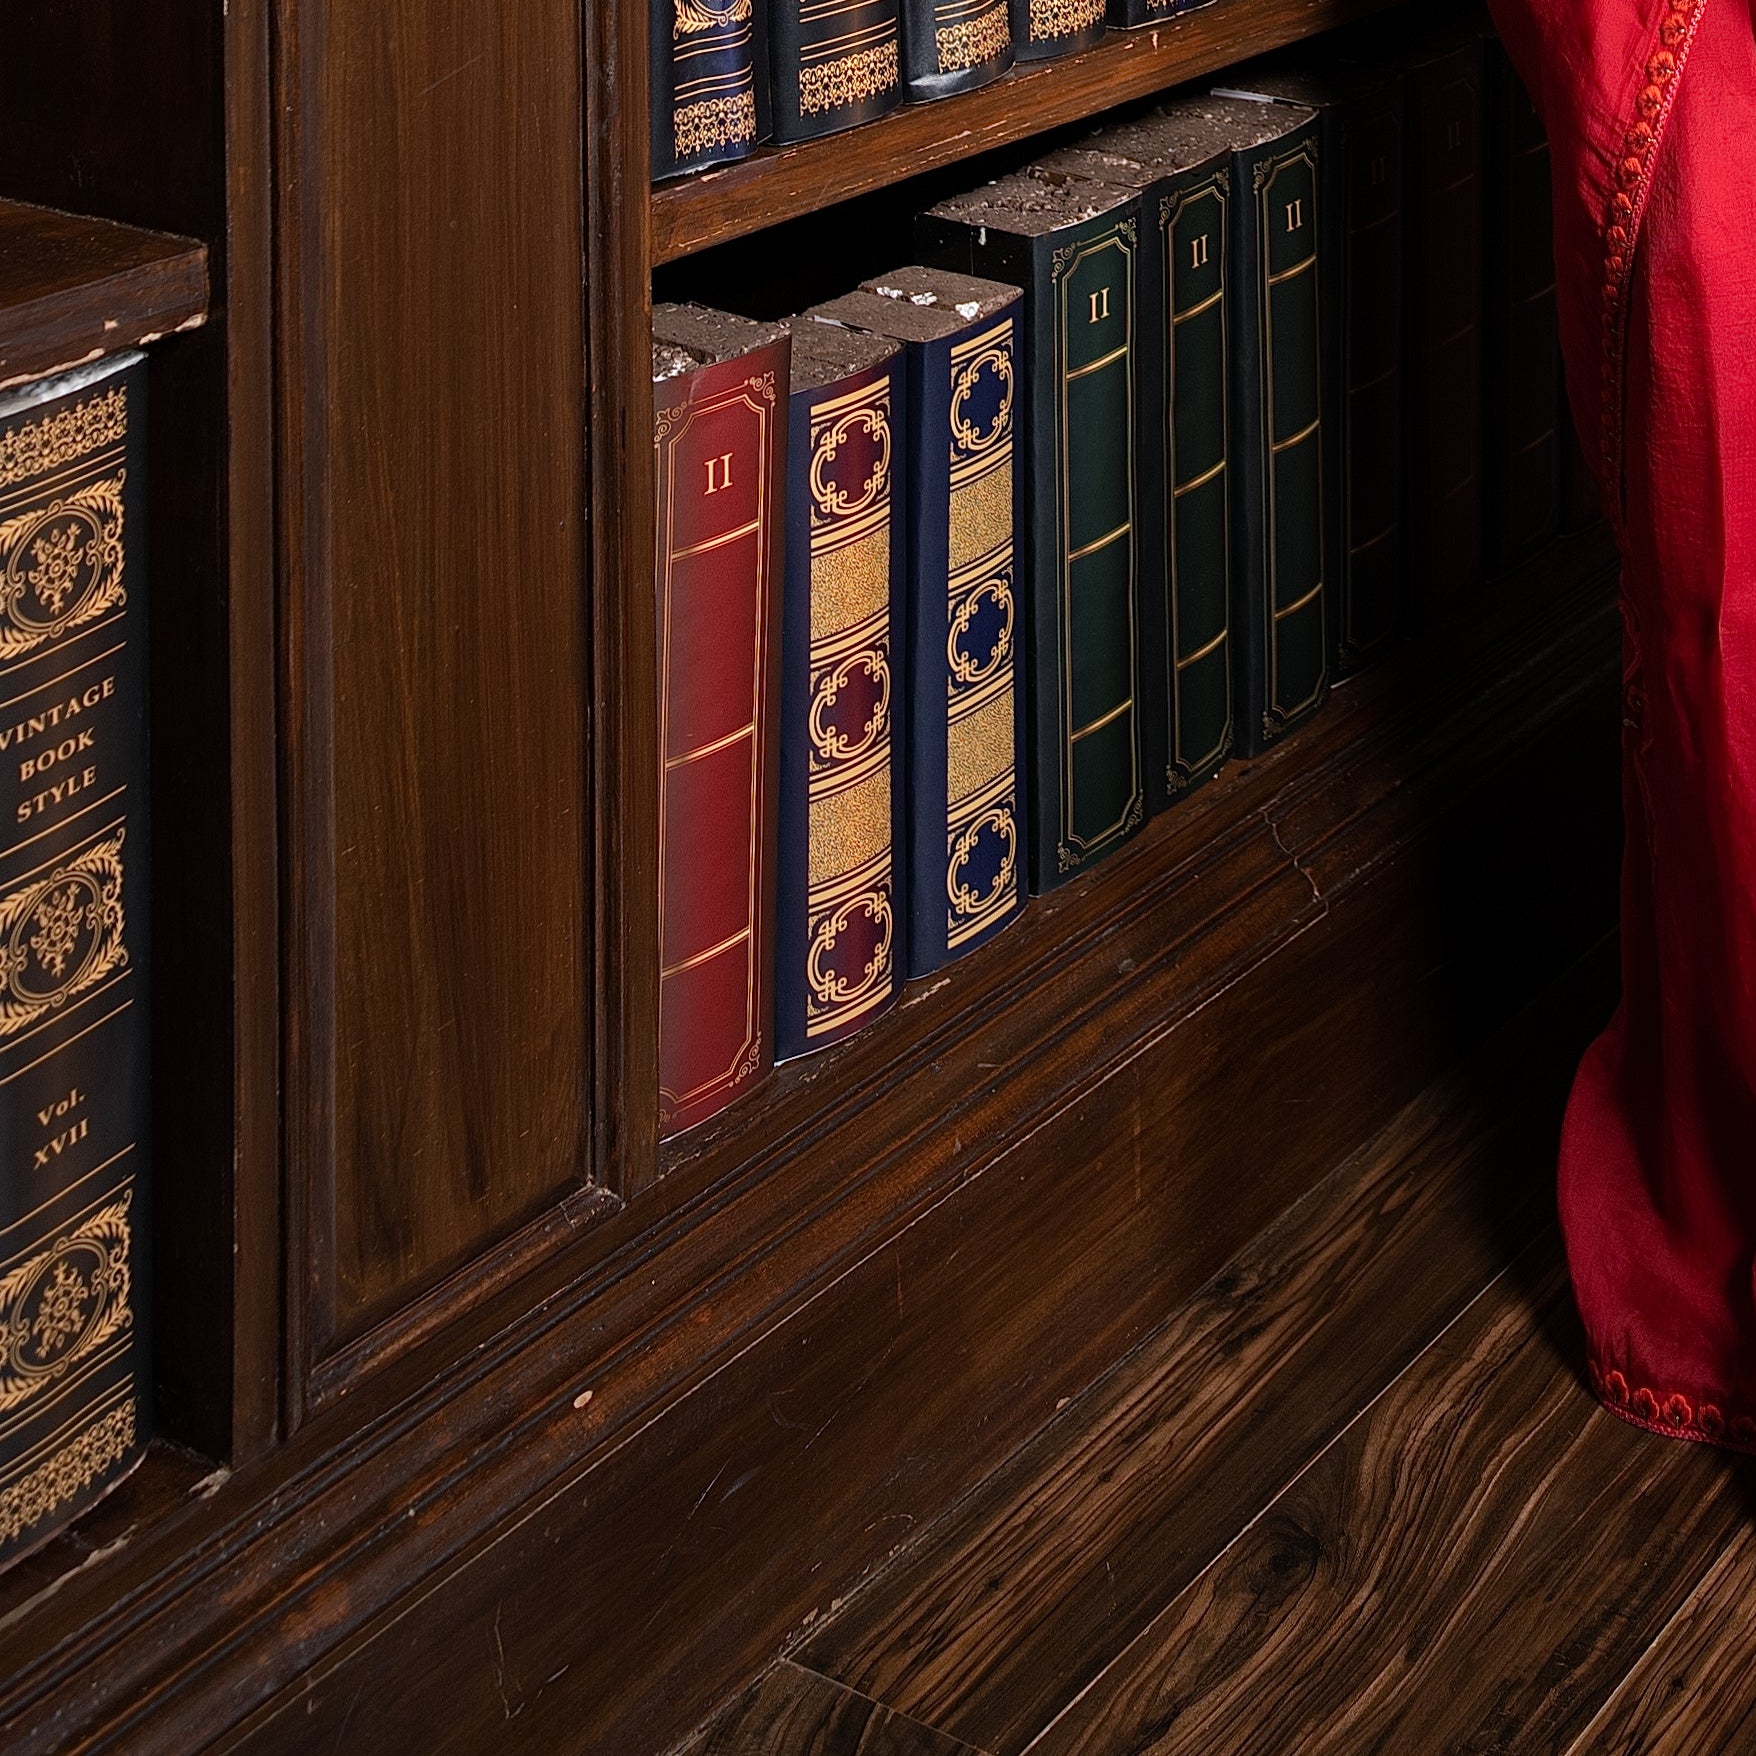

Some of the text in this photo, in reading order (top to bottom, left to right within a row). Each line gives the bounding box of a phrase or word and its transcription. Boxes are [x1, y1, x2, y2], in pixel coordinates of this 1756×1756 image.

[1286, 198, 1303, 232] II
[1190, 234, 1208, 269] II
[1088, 287, 1110, 324] II
[703, 452, 733, 496] II
[0, 675, 116, 752] VINTAGE
[20, 726, 96, 783] BOOK
[17, 764, 97, 824] STYLE
[37, 1088, 87, 1127] Vol.
[33, 1117, 89, 1171] XVII
